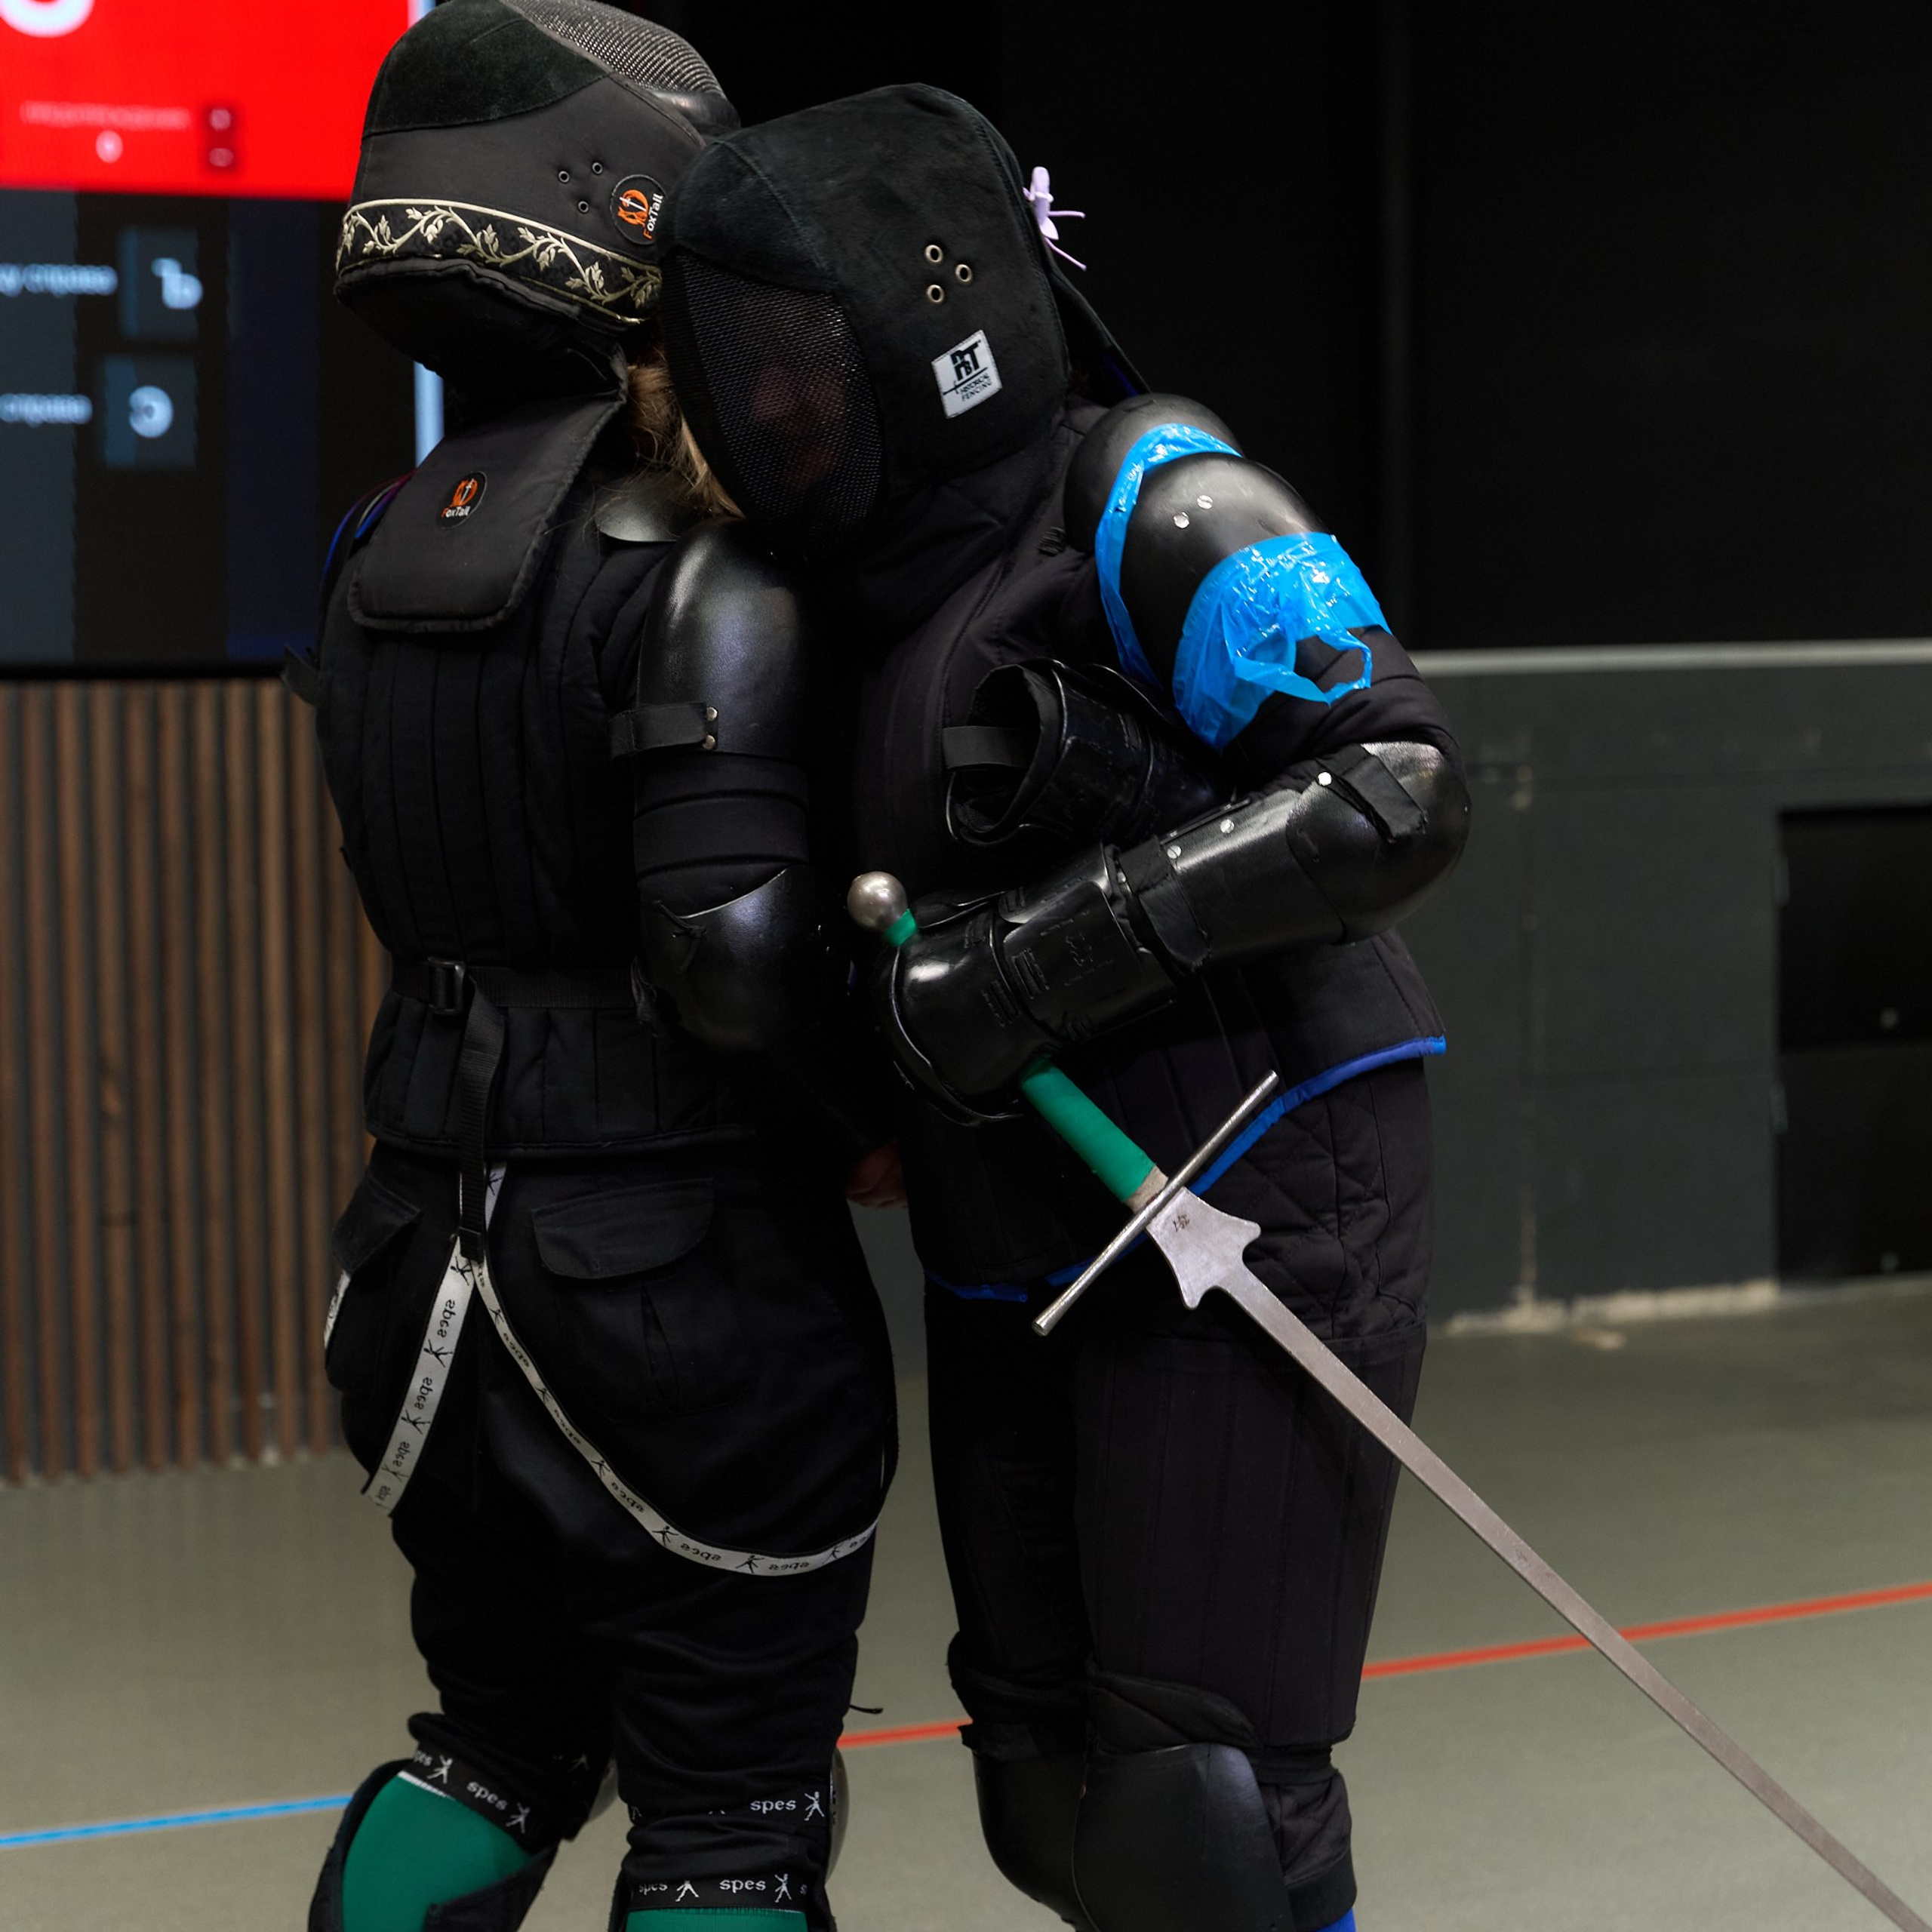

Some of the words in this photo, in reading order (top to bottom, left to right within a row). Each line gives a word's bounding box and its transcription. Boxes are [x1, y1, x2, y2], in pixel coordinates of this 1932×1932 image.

[643, 193, 664, 240] FoxTail
[441, 505, 471, 518] FoxTail
[466, 1781, 509, 1811] spes
[749, 1799, 797, 1815] spes
[719, 1878, 767, 1894] spes
